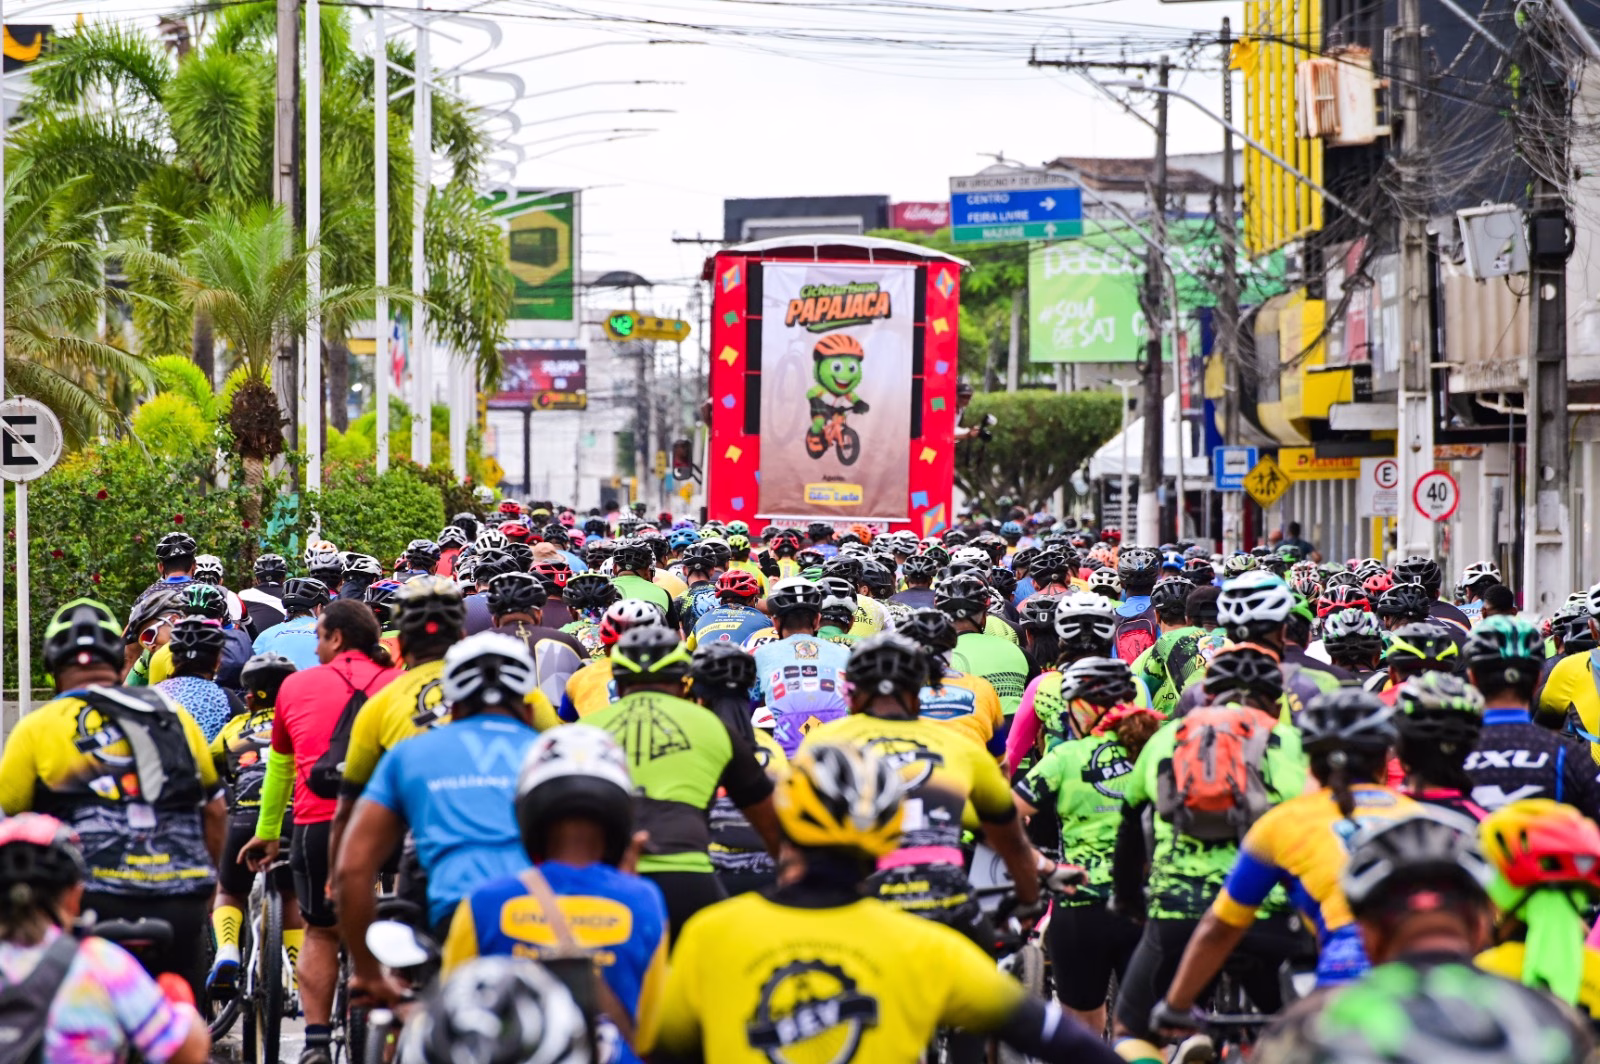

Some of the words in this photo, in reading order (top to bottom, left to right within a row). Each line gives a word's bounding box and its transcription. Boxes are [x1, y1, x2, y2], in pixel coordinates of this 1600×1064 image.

[966, 194, 1010, 206] CENTRO
[967, 212, 998, 223] FEIRA
[999, 210, 1030, 221] LIVRE
[784, 291, 891, 327] PAPAJACA
[2, 415, 39, 466] E
[1382, 467, 1392, 482] E
[1427, 482, 1448, 502] 40
[854, 615, 873, 625] BIKE
